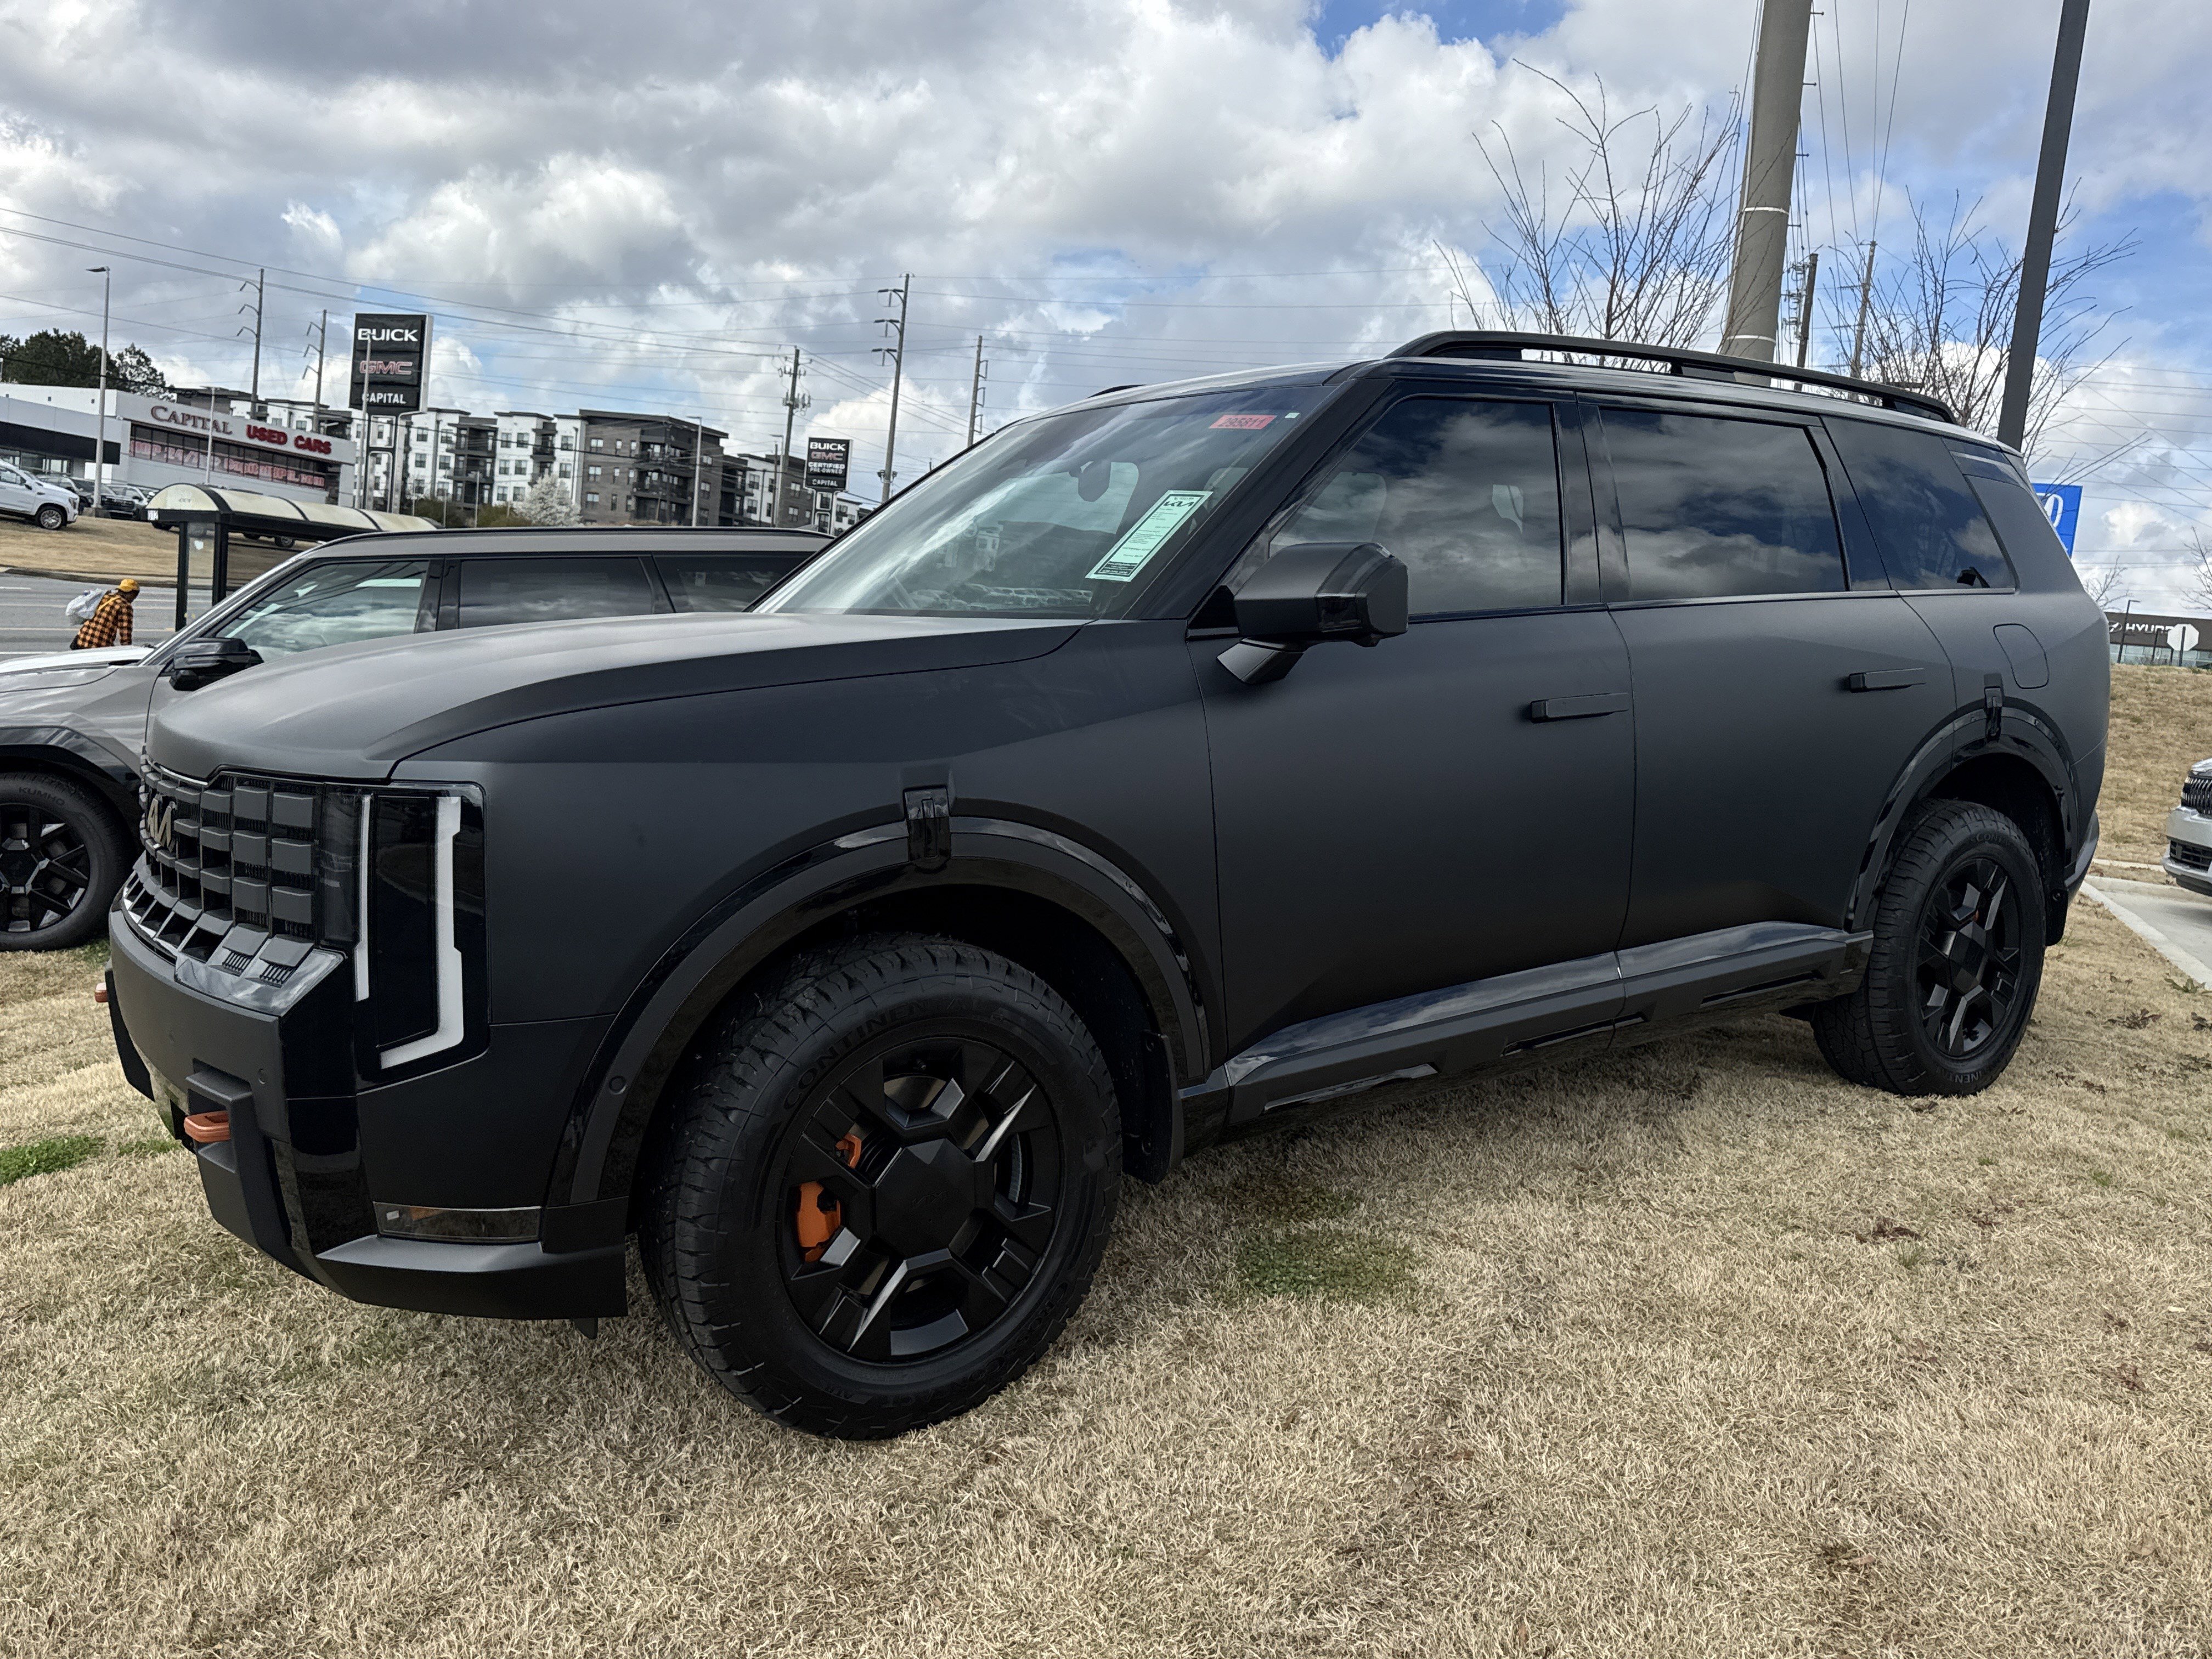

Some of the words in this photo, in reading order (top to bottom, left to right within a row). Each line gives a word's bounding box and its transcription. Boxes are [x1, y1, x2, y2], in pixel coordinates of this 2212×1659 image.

[357, 328, 419, 342] BUICK
[359, 360, 413, 375] GMC
[362, 392, 407, 404] CAPITAL
[151, 405, 233, 435] CAPITAL
[246, 425, 287, 445] USED
[294, 435, 332, 455] CARS
[810, 442, 845, 450] BUICK
[811, 452, 843, 460] GMC
